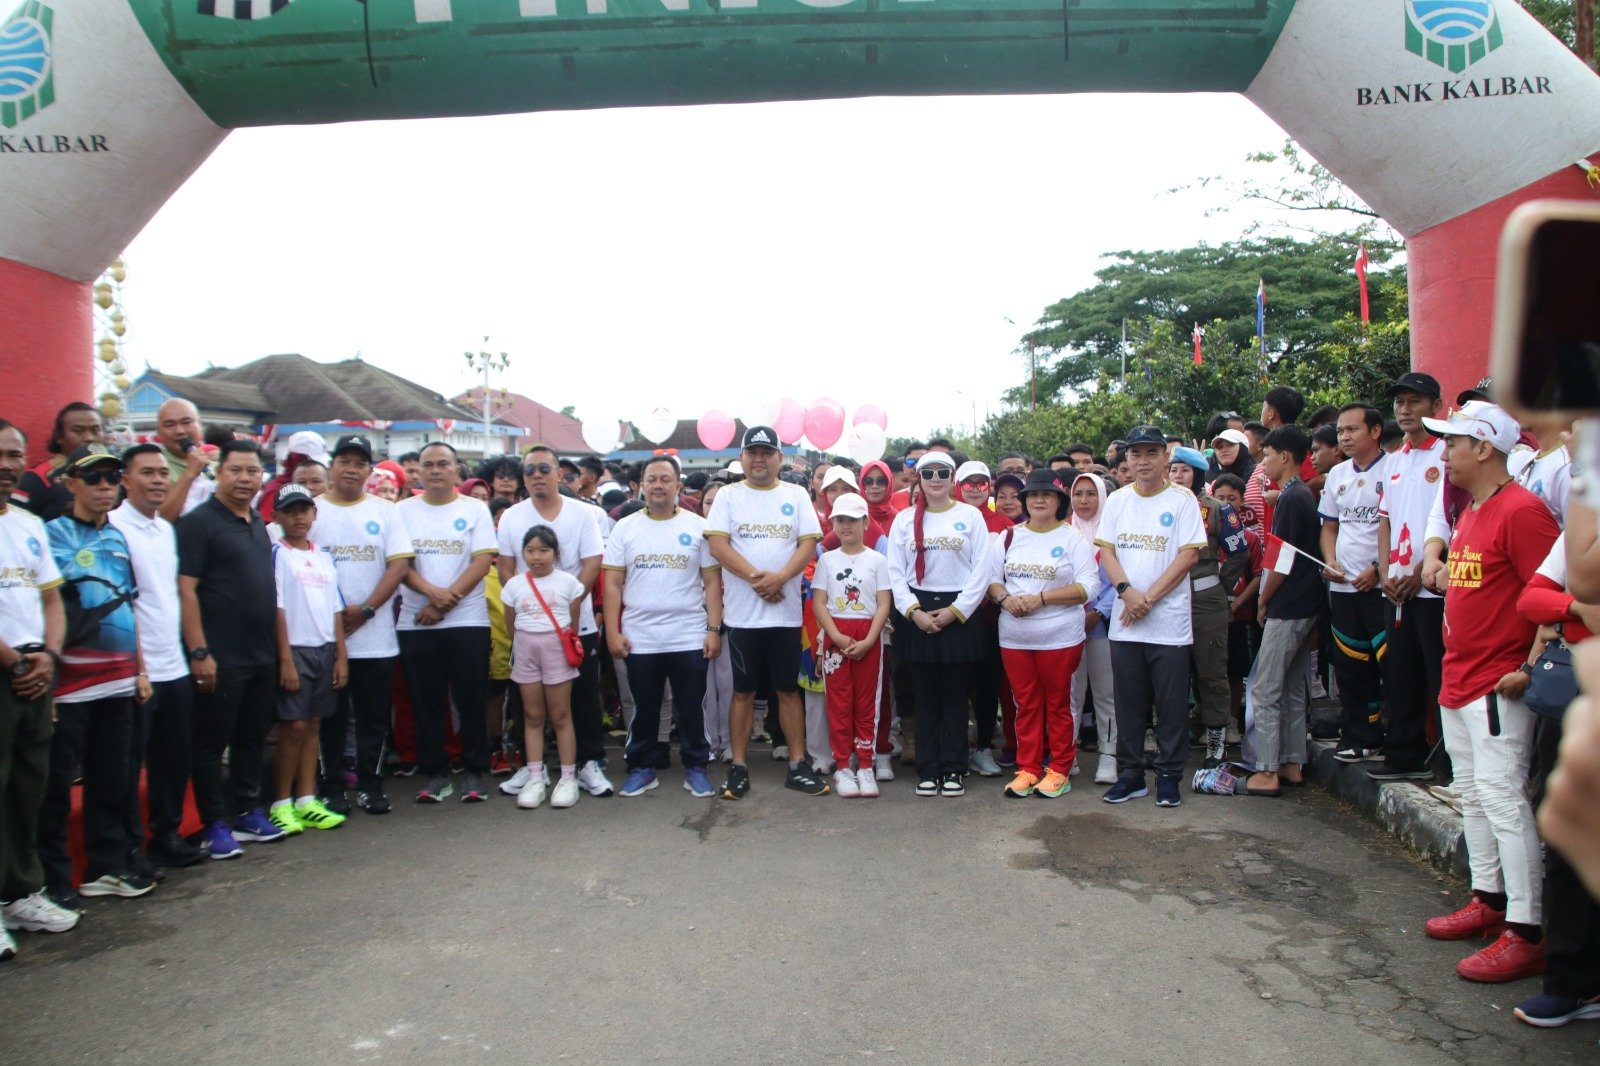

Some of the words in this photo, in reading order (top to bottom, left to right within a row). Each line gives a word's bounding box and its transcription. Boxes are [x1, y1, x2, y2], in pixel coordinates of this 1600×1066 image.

[1356, 83, 1434, 106] BANK
[1442, 76, 1553, 100] KALBAR
[1144, 544, 1167, 552] 2025
